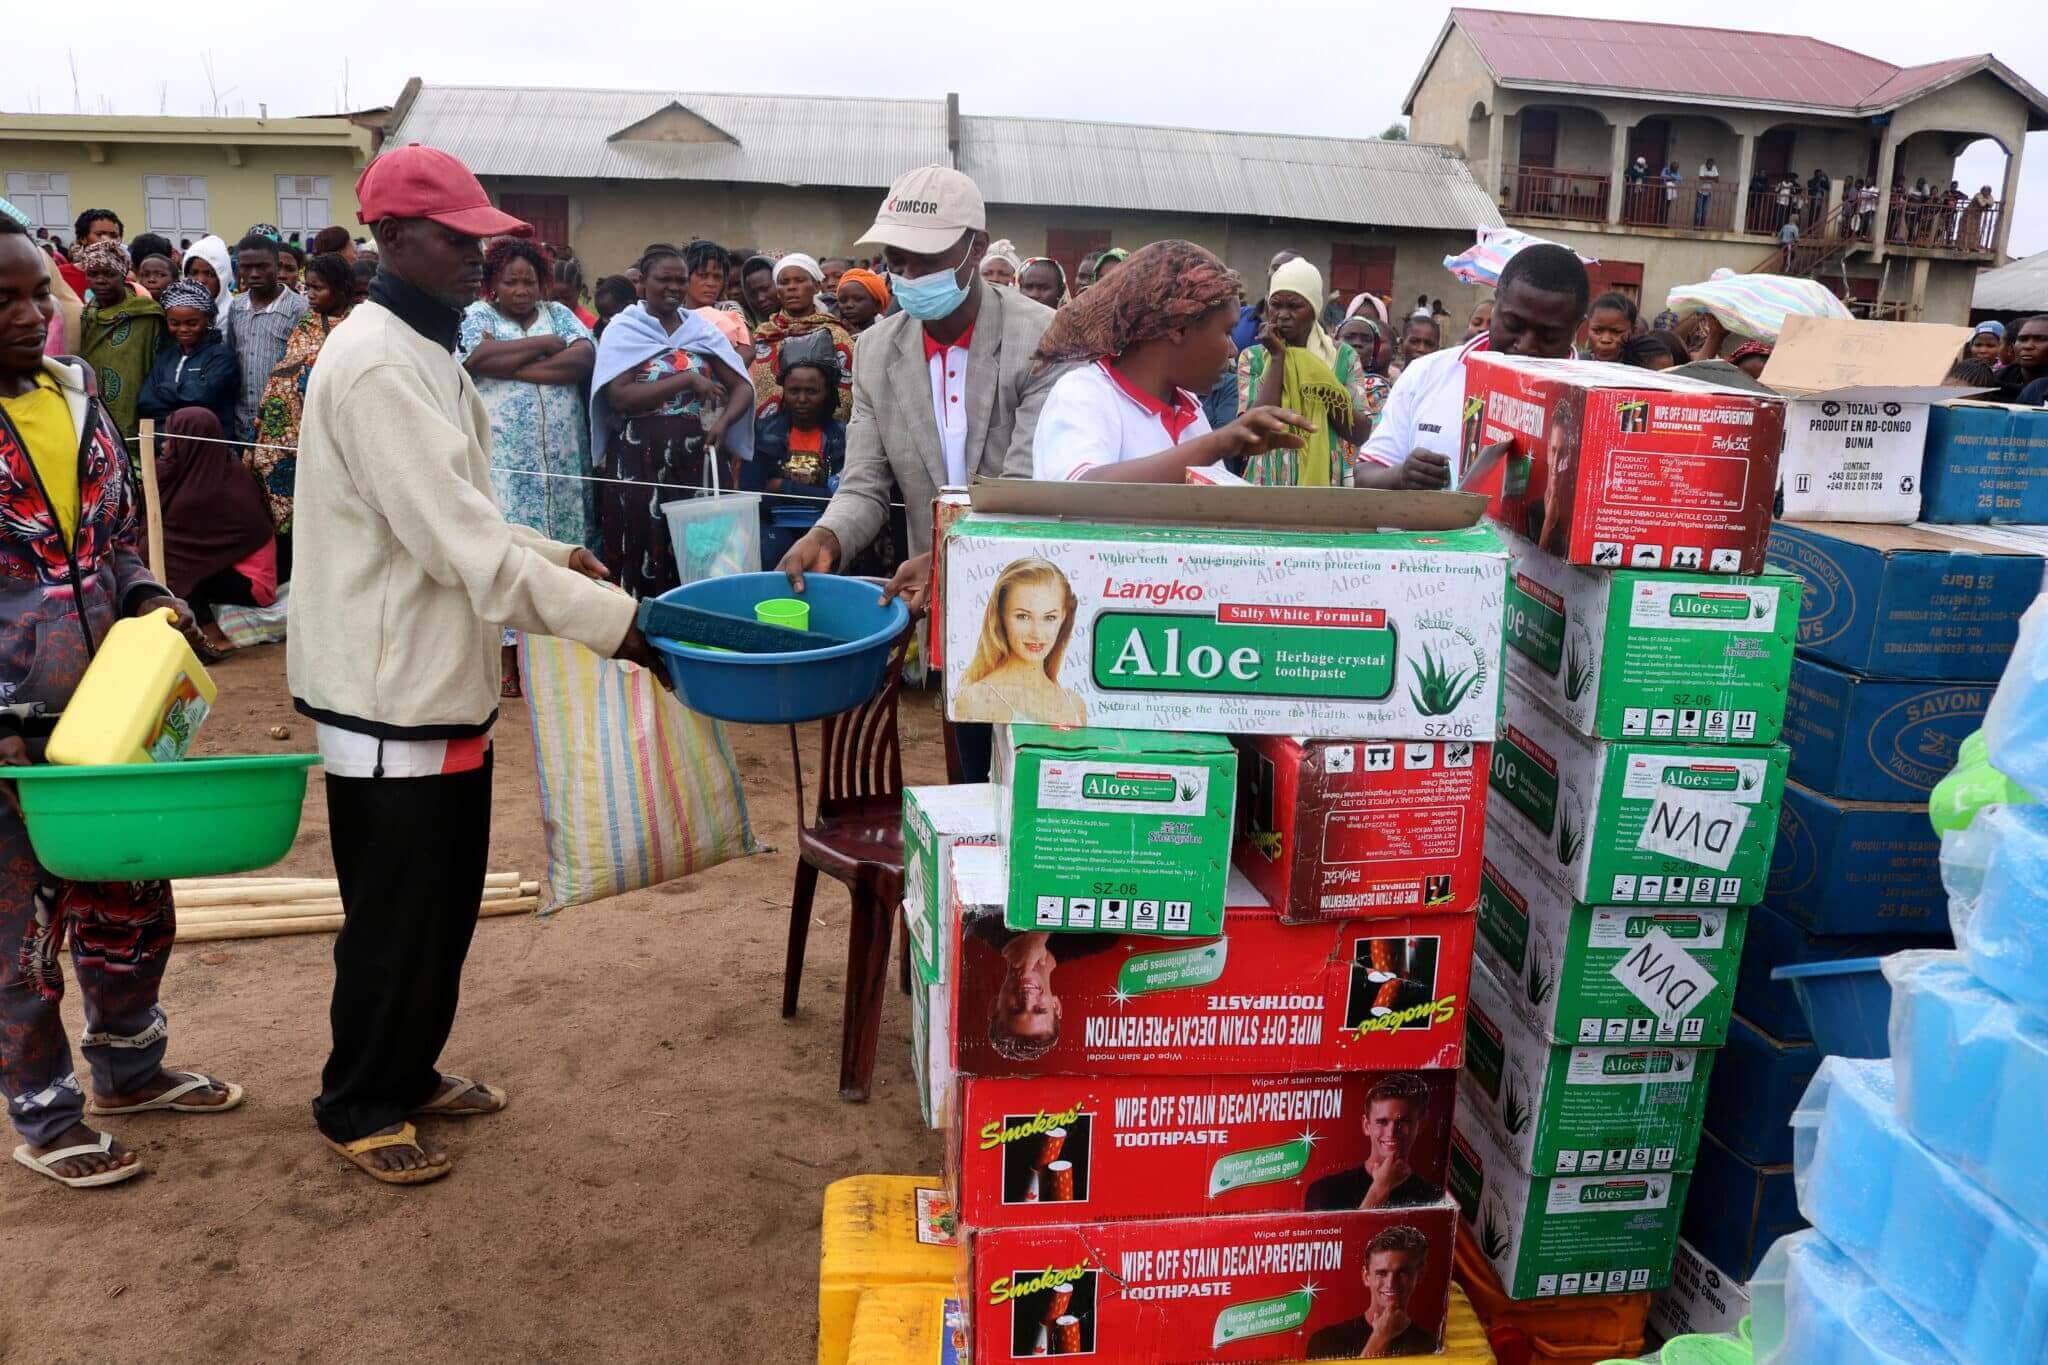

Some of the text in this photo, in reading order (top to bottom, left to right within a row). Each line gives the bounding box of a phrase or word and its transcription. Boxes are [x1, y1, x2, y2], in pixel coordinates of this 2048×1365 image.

[895, 200, 938, 214] UMCOR
[1654, 405, 1670, 420] WIPE
[1669, 407, 1681, 421] OFF
[1681, 408, 1698, 422] STAIN
[1847, 403, 1878, 415] TOZALI
[1652, 421, 1703, 431] TOOTHPASTE
[1810, 420, 1912, 433] PRODUIT EN RD-CONGO
[1845, 437, 1874, 449] BUNIA
[1842, 462, 1870, 470] CONTACT
[1828, 472, 1844, 480] +243
[1827, 482, 1883, 490] +243 724
[1977, 495, 2021, 508] 25 Bars
[1141, 554, 1168, 564] teeth
[1187, 554, 1266, 568] Anti-gingivitis
[1324, 561, 1382, 572] protection
[1399, 565, 1482, 576] Fresher breath
[1941, 574, 1995, 588] 25 Bars
[1102, 577, 1203, 605] Langko
[1673, 599, 1719, 615] Aloes
[1231, 606, 1374, 624] Salty White Formula
[1108, 627, 1263, 681] Aloe
[1276, 651, 1386, 667] Herbage crystal
[1275, 666, 1347, 681] toothpaste
[1672, 694, 1713, 706] SZ-06
[1098, 700, 1140, 713] Natural
[1195, 704, 1213, 713] the
[1219, 704, 1248, 716] tooth
[1253, 708, 1281, 718] more
[1288, 708, 1305, 718] the
[1906, 692, 1981, 723] SAVON
[1712, 711, 1723, 724] 6
[1424, 723, 1474, 738] SZ-06
[1664, 770, 1710, 786] Aloes
[1086, 778, 1140, 796] Aloes
[1661, 862, 1699, 873] SZ-06
[1092, 882, 1138, 895] SZ-06
[1371, 882, 1421, 891] TOOTHPASTE
[1699, 879, 1709, 890] 6
[1376, 893, 1393, 906] STAIN
[1392, 892, 1404, 905] OFF
[1403, 891, 1419, 904] WIPE
[1140, 902, 1152, 916] 6
[1130, 960, 1149, 973] gene
[1207, 995, 1325, 1010] TOOTHPASTE
[1085, 1016, 1322, 1048] WIPE OFF STAIN DECAY-PREVENTION
[1087, 1053, 1183, 1061] Wipe off stain model
[1605, 1056, 1647, 1072] Aloes
[1251, 1074, 1342, 1087] Wipe off stain model
[1115, 1088, 1343, 1128] WIPE OFF STAIN DECAY-PREVENTION
[980, 1101, 1083, 1150] Smokers'
[1114, 1130, 1228, 1147] TOOTHPASTE
[1635, 1149, 1645, 1161] 6
[1282, 1159, 1299, 1175] gene
[1583, 1186, 1622, 1200] Aloes
[1254, 1227, 1342, 1239] Wipe off stain model
[1121, 1241, 1343, 1281] WIPE OFF STAIN DECAY-PREVENTION
[990, 1258, 1092, 1305] Smokers'
[1612, 1271, 1622, 1282] 6
[1121, 1282, 1231, 1300] TOOTHPASTE
[1284, 1310, 1301, 1326] gene
